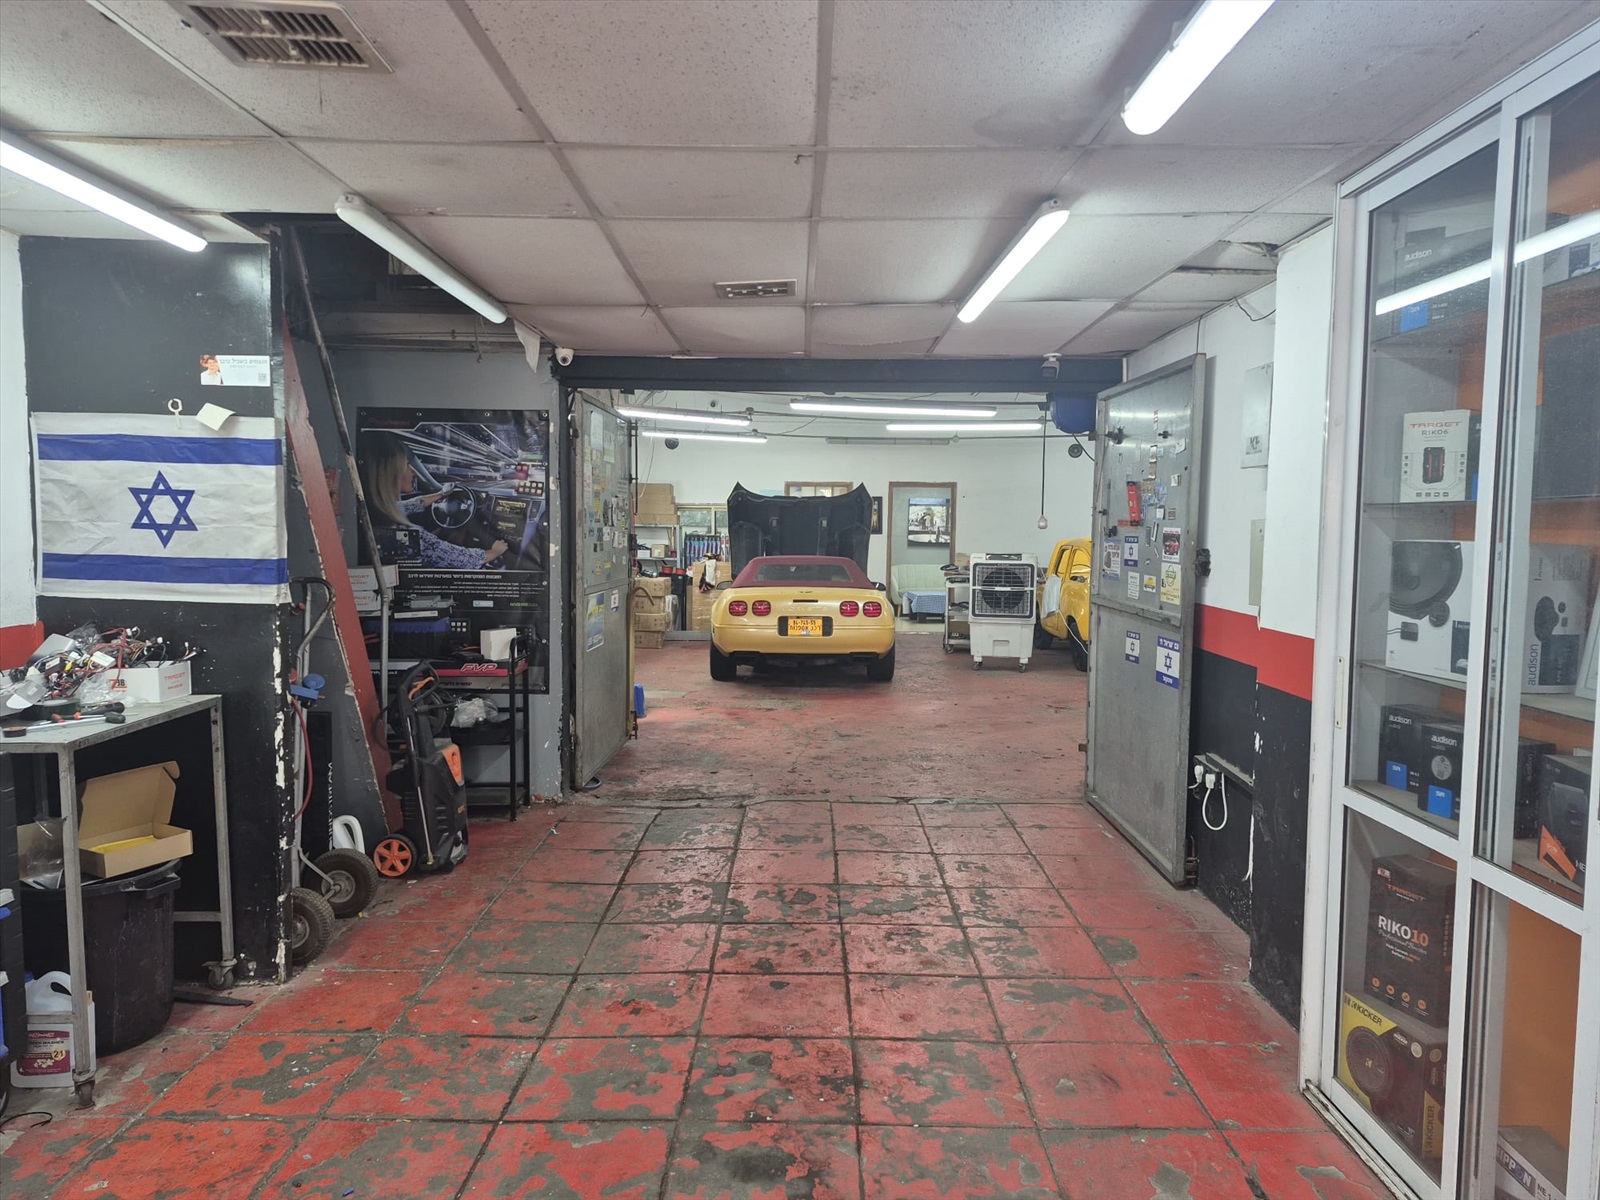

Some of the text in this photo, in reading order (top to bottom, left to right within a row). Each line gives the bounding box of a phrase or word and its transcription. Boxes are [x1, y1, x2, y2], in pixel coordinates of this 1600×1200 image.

[1404, 249, 1432, 261] audison
[1409, 421, 1462, 429] TARGET
[461, 662, 498, 673] FVP
[1527, 643, 1539, 686] audison
[1388, 714, 1412, 725] audison
[1430, 734, 1458, 747] audison
[1386, 883, 1427, 901] TARGET
[1378, 915, 1430, 948] RIKO10
[1356, 1002, 1384, 1026] KICKER
[1427, 1105, 1435, 1141] KICKER
